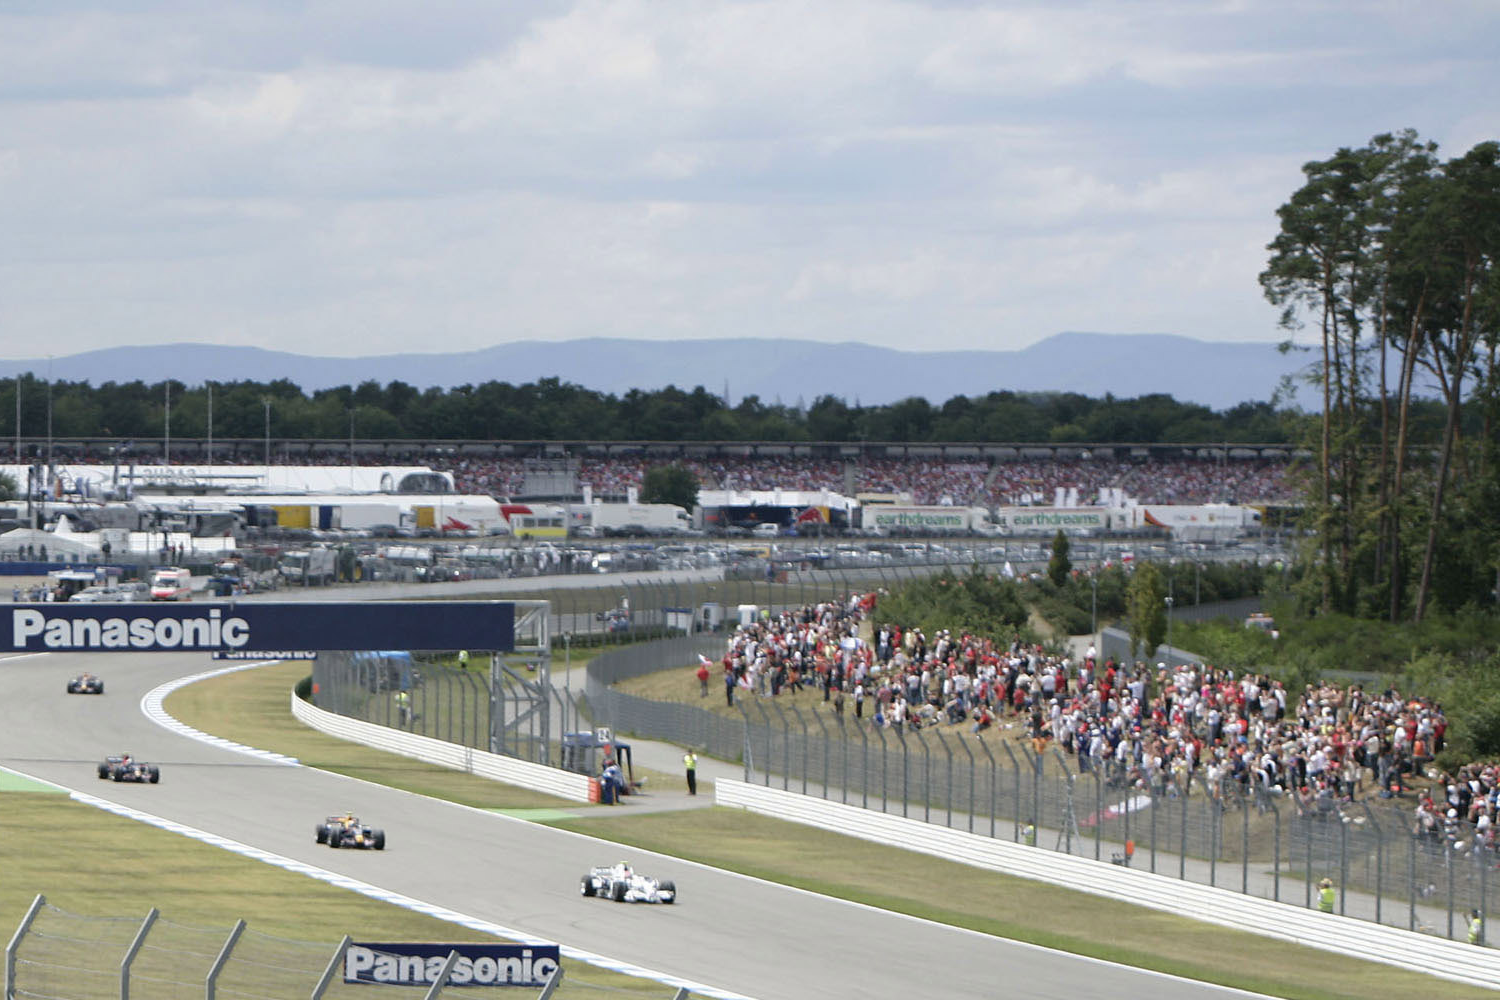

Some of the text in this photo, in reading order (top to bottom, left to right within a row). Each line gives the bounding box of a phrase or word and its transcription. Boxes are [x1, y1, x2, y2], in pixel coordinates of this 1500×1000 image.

[875, 511, 962, 526] earthdreams
[1013, 511, 1100, 526] earthdreams
[12, 608, 250, 649] Panasonic
[345, 945, 558, 988] Panasonic
